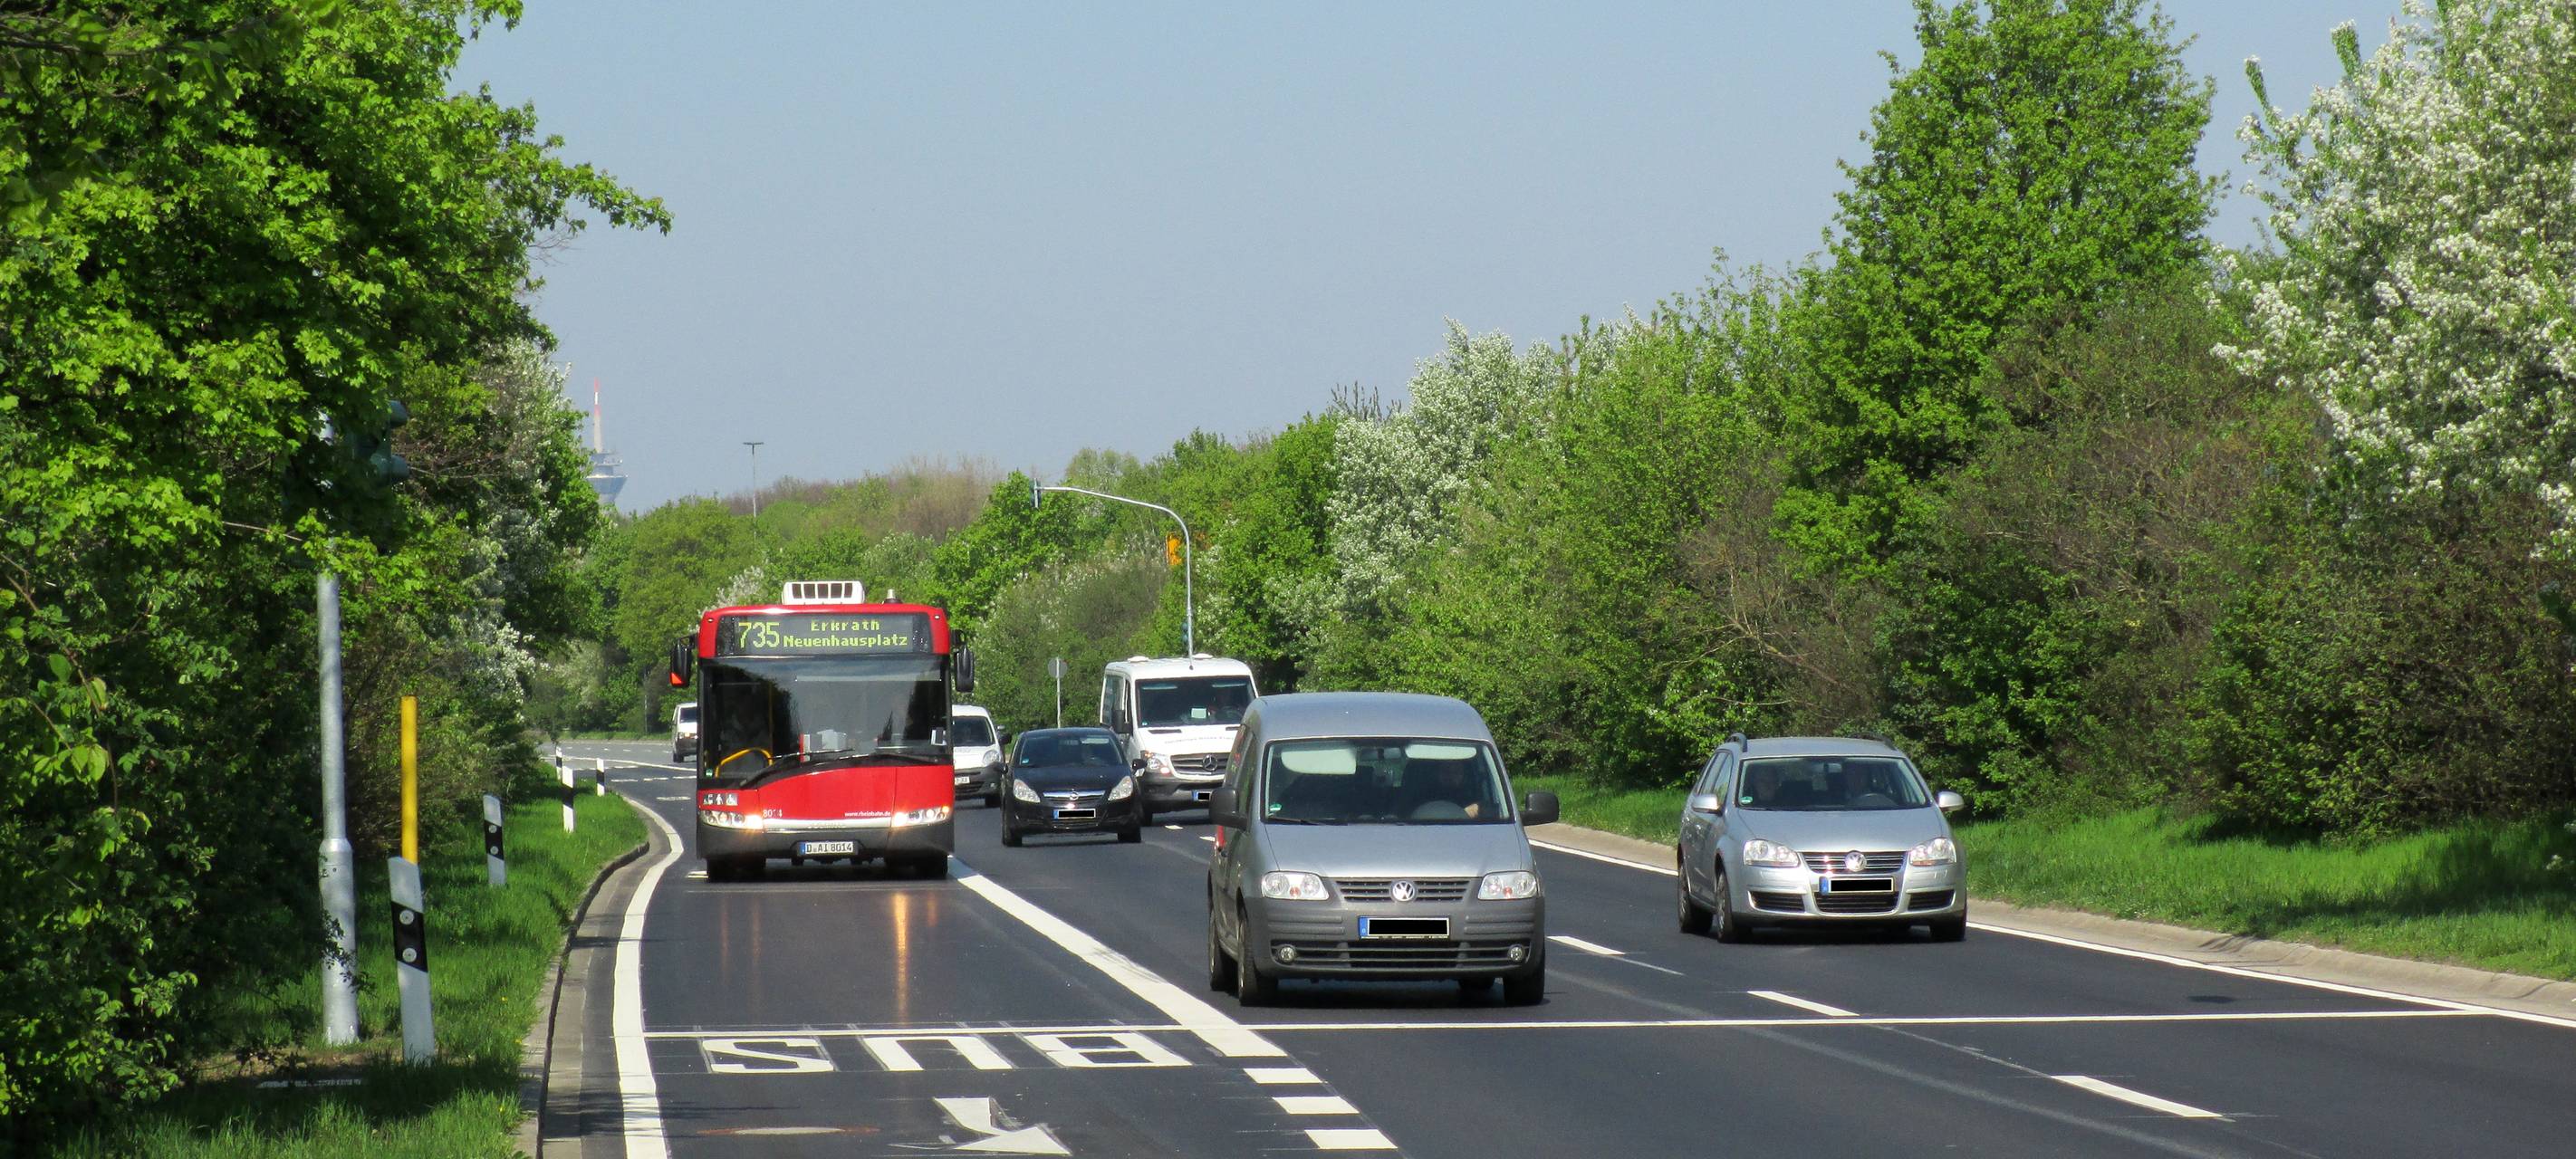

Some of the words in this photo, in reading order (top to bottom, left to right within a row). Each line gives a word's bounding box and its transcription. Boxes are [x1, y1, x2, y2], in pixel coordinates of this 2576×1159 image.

[811, 619, 880, 632] Erkrath
[738, 622, 780, 648] 735
[783, 635, 908, 647] Neuenhausplatz
[831, 843, 852, 852] 8014
[702, 1032, 1194, 1075] BUS
